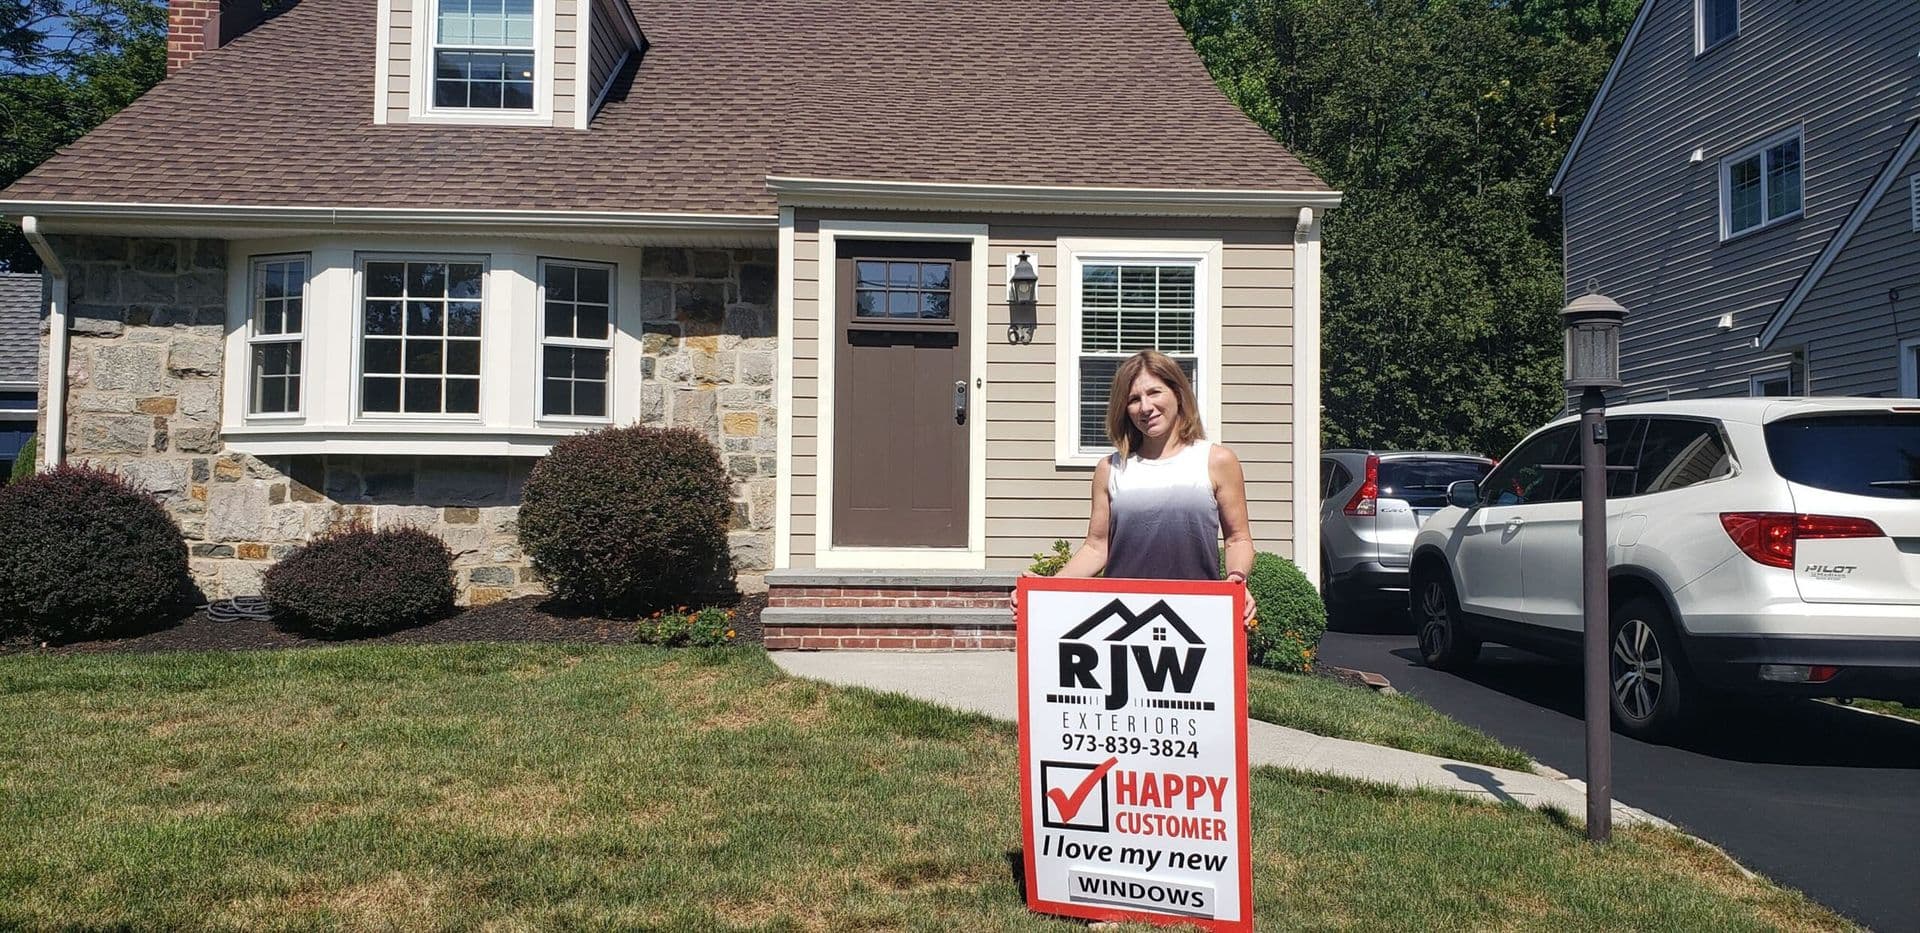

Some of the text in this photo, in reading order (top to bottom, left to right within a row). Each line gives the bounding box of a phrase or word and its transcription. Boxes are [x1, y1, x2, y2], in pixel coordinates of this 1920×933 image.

[1805, 565, 1857, 574] PILOT
[1059, 642, 1207, 710] RJW
[1063, 712, 1197, 736] EXTERIORS
[1062, 733, 1200, 758] 973-839-3824
[1115, 770, 1228, 812] HAPPY
[1115, 812, 1228, 841] CUSTOMER
[1043, 835, 1228, 872] I love my new
[1078, 876, 1204, 908] WINDOWS
